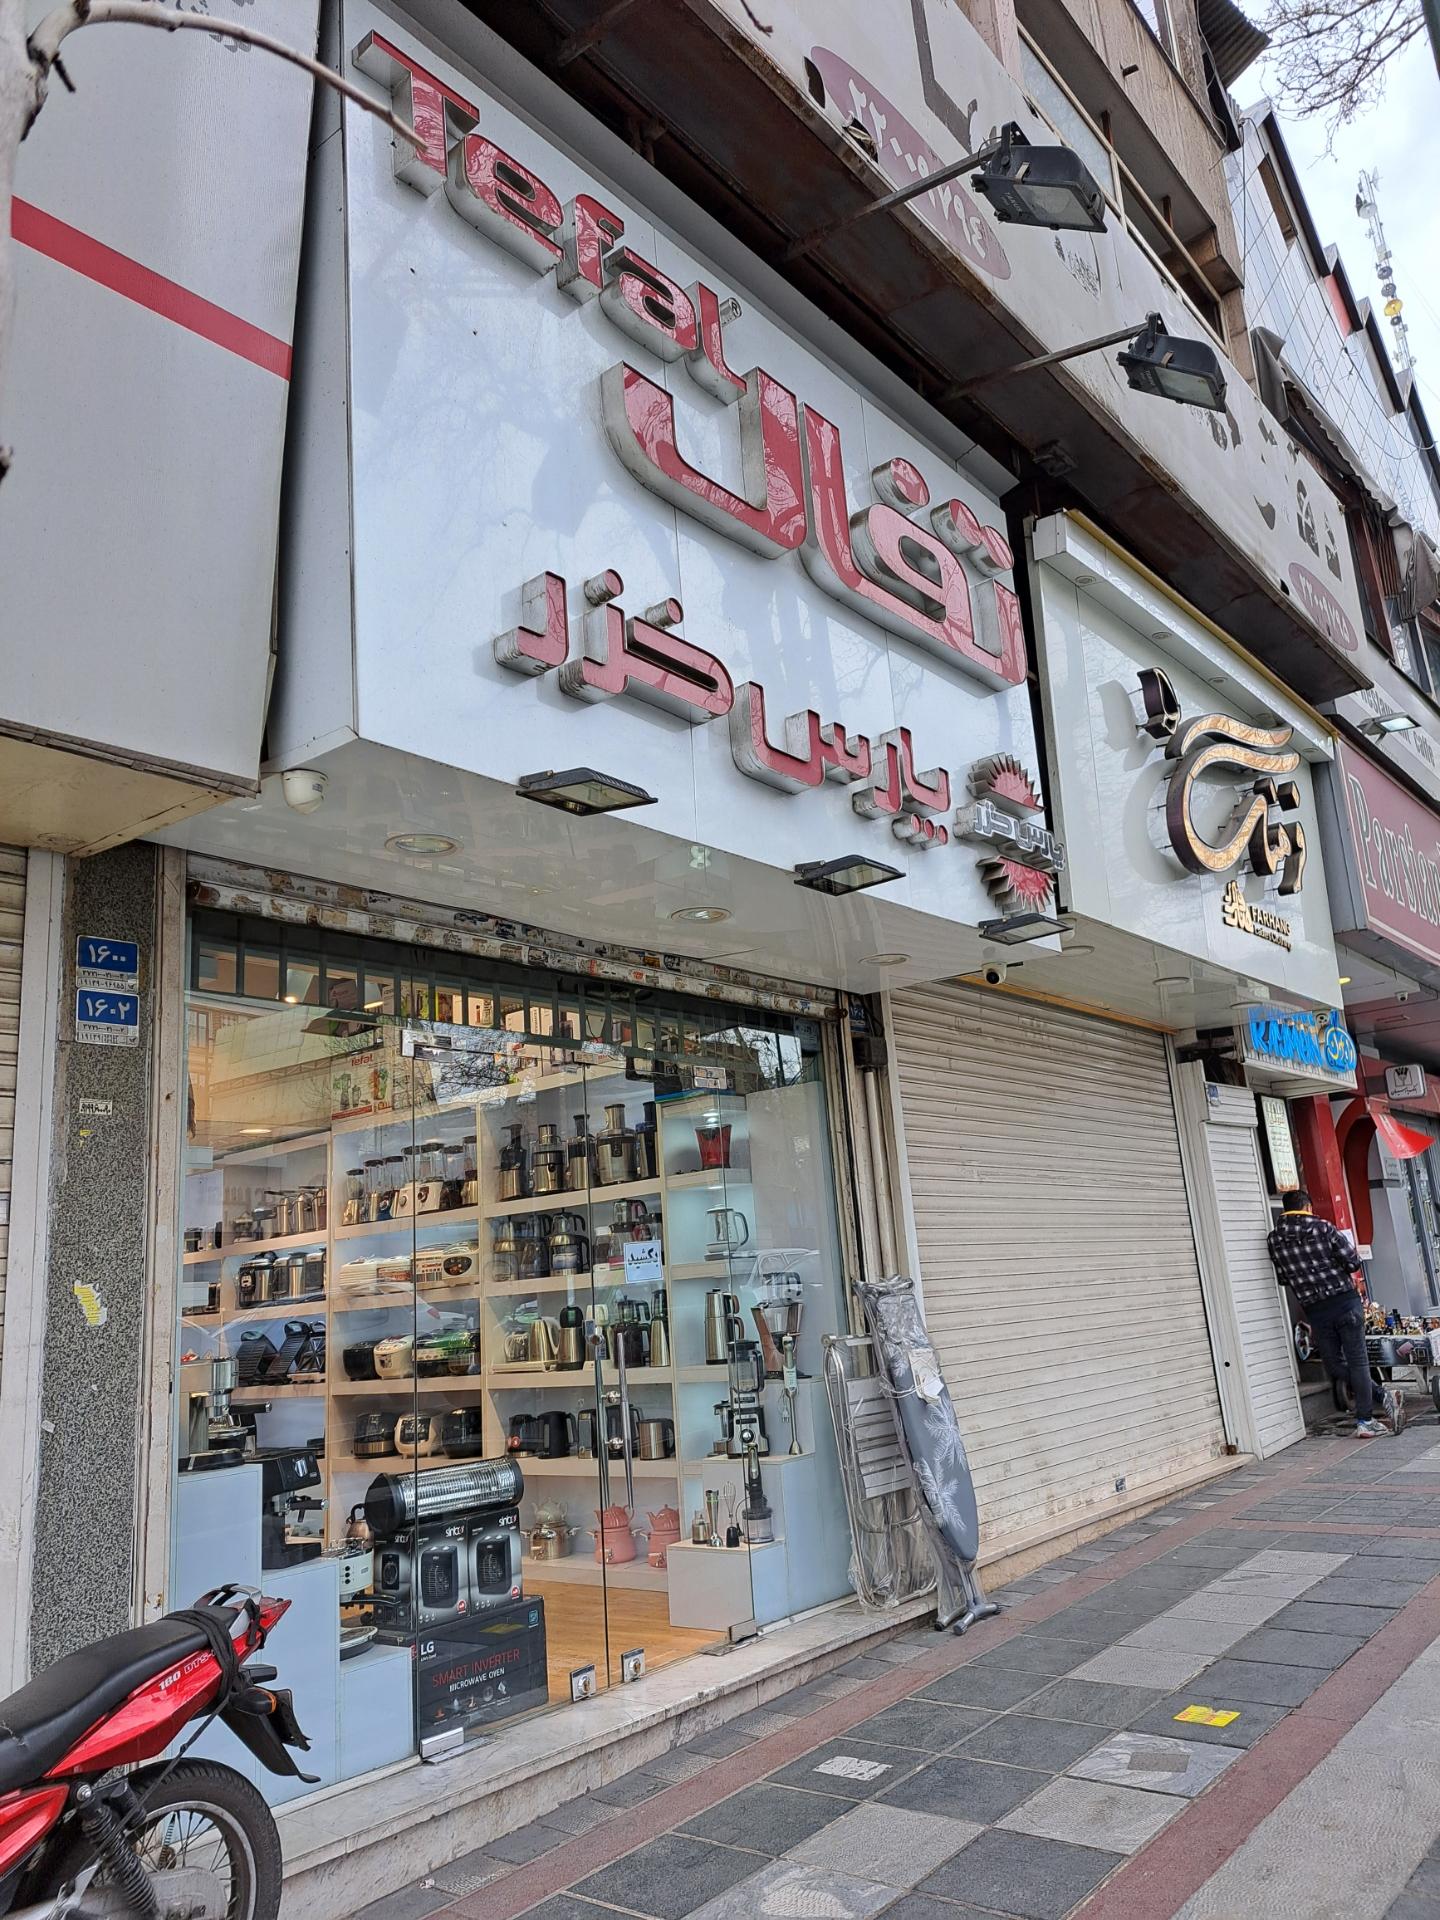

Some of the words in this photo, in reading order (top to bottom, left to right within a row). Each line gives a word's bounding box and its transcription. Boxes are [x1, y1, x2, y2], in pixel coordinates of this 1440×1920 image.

[352, 28, 748, 400] Tefal
[602, 360, 1028, 696] تفال
[494, 567, 736, 725] خزر
[732, 680, 953, 850] پارس
[973, 799, 1014, 838] خزر
[1250, 906, 1291, 936] FARHANG
[88, 943, 126, 963] ۱۶۰۰
[86, 997, 130, 1020] ۱۶۰۲
[628, 1247, 658, 1269] بکشید
[420, 1641, 435, 1656] LG
[432, 1663, 469, 1688] SMART
[471, 1648, 521, 1674] INVERTER
[449, 1672, 487, 1692] MICROWAVE
[488, 1667, 505, 1679] OVEN
